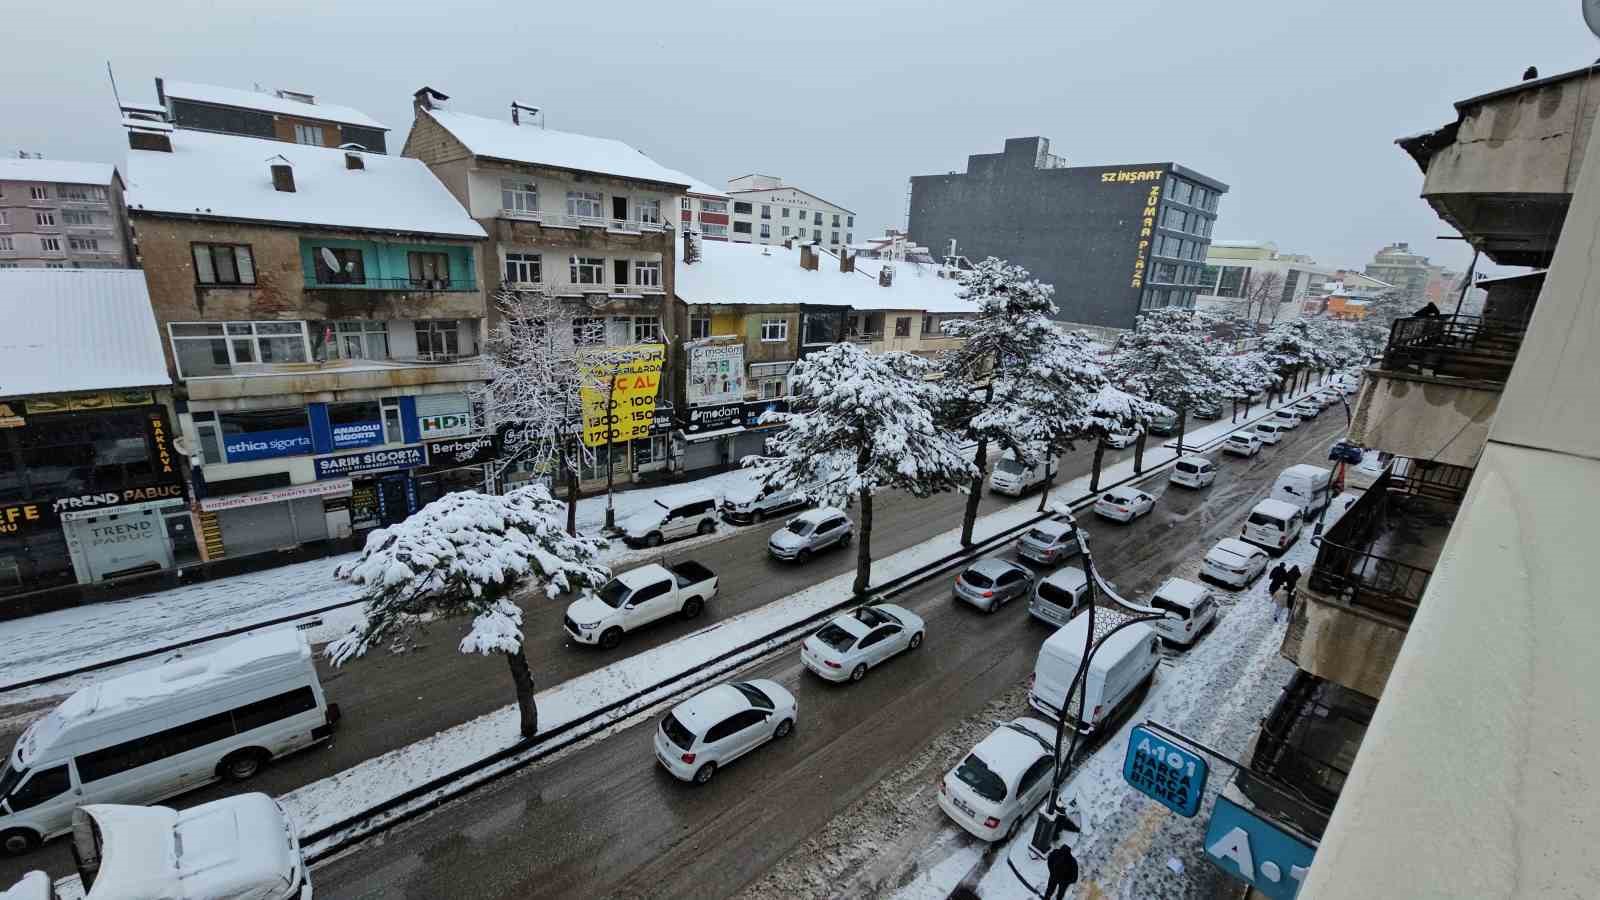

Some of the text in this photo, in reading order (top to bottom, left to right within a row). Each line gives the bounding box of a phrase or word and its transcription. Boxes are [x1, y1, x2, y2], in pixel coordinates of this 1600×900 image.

[334, 423, 380, 434] ANADOLU
[152, 420, 173, 472] BAKLAVA
[227, 436, 312, 453] ethica sigorta
[58, 493, 119, 510] TREND
[91, 520, 151, 537] TREND
